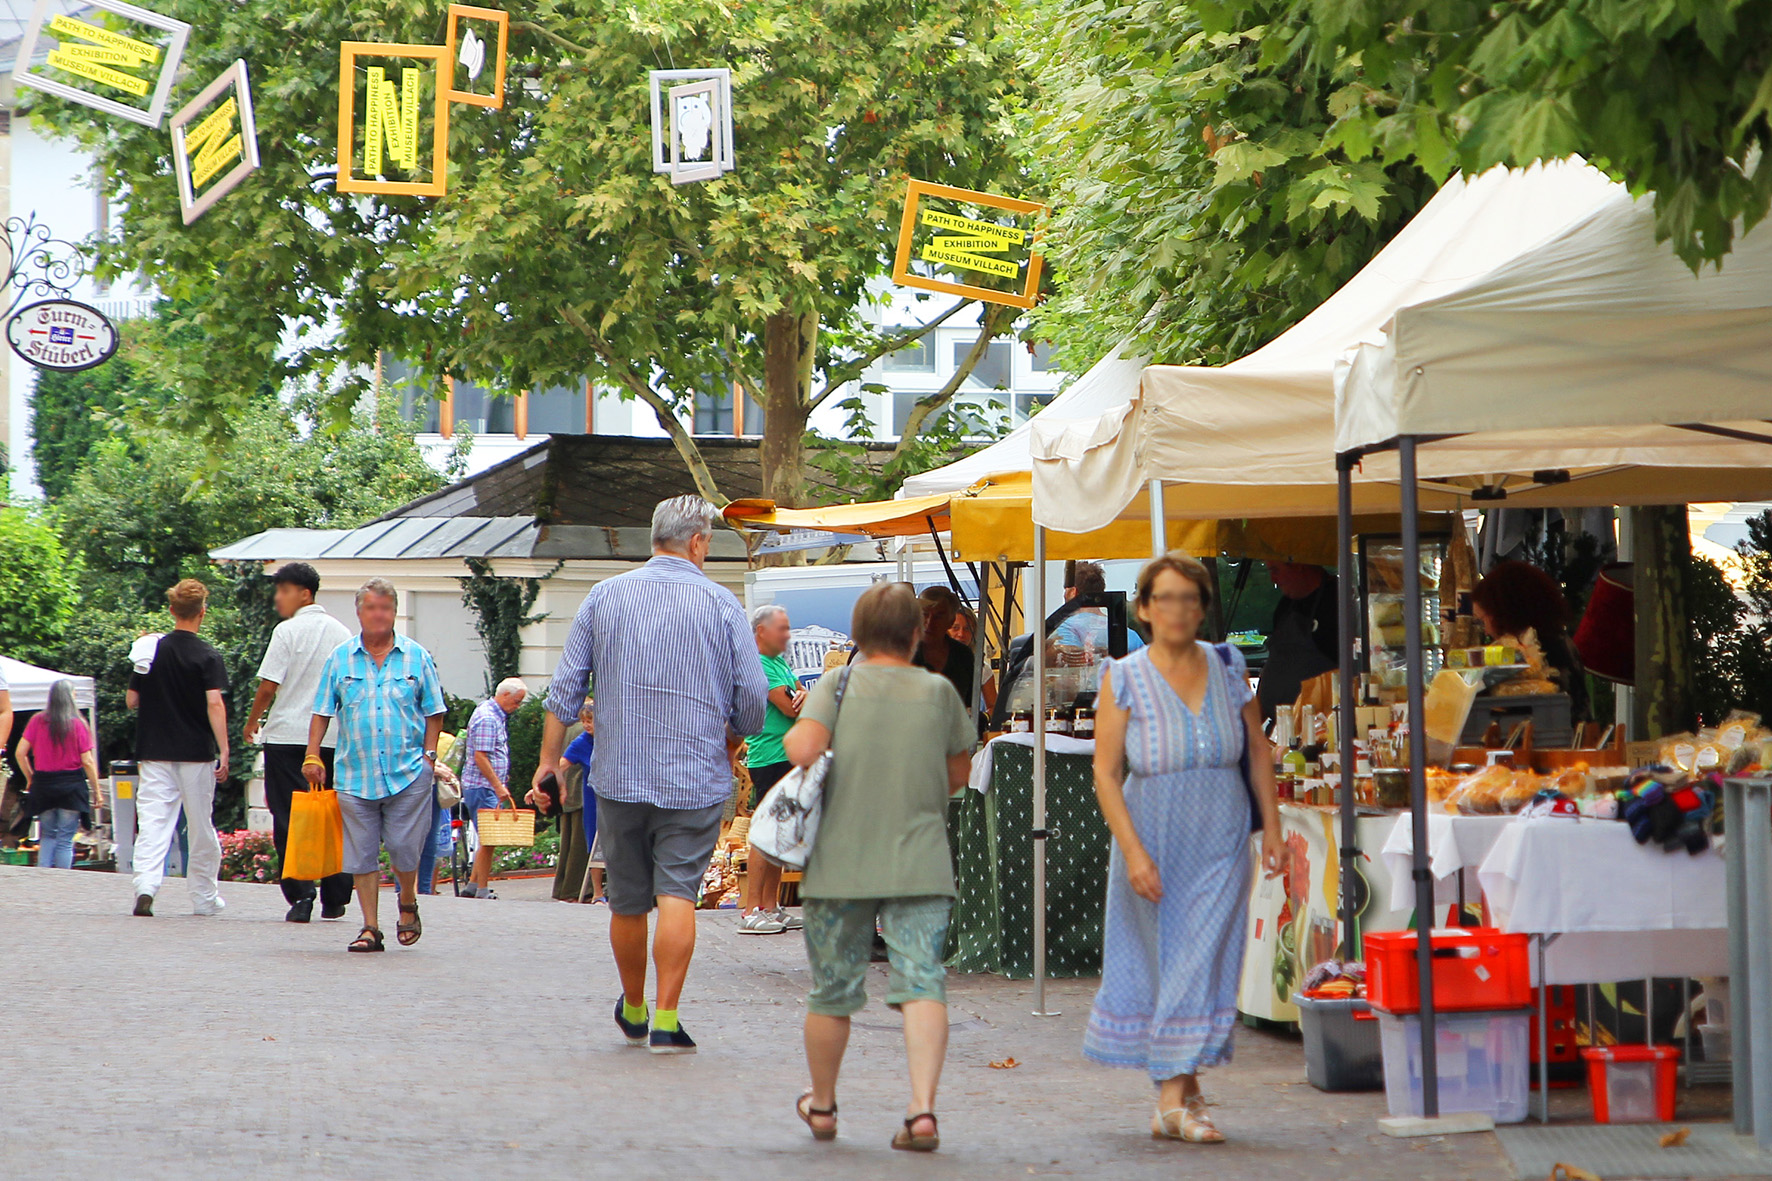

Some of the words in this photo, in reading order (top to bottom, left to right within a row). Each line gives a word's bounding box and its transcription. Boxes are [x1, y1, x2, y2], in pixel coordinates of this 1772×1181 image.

[56, 18, 80, 32] PATH
[83, 27, 96, 37] TO
[97, 33, 152, 57] HAPPINESS
[70, 47, 128, 62] EXHIBITION
[53, 55, 97, 76] MUSEUM
[100, 70, 141, 90] VILLACH
[371, 71, 380, 127] HAPPINESS
[406, 73, 415, 114] VILLACH
[383, 92, 400, 149] EXHIBITION
[369, 129, 378, 142] TO
[404, 118, 413, 162] MUSEUM
[368, 144, 378, 170] PATH
[927, 213, 950, 225] PATH
[953, 219, 965, 228] TO
[967, 222, 1020, 240] HAPPINESS
[944, 239, 998, 248] EXHIBITION
[928, 249, 971, 265] MUSEUM
[973, 259, 1014, 275] VILLACH
[24, 340, 94, 364] Stüberl
